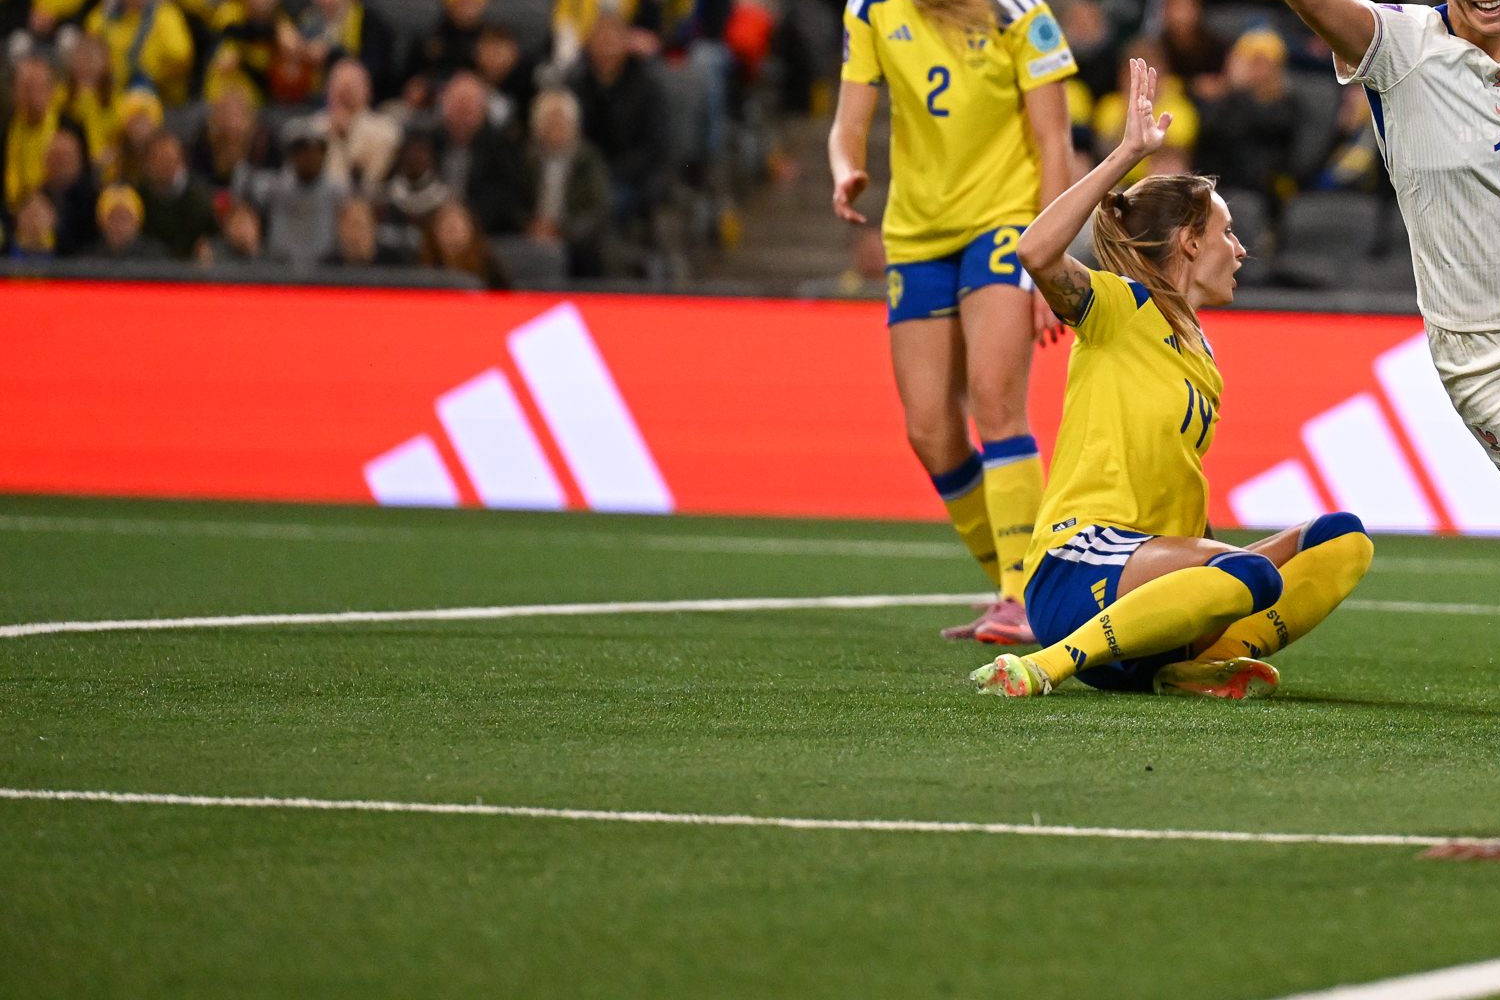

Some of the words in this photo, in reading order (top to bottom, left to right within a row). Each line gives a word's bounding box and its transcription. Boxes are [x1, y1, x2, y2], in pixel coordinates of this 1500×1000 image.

[927, 66, 950, 117] 2
[989, 226, 1021, 274] 2
[1180, 378, 1213, 449] 14
